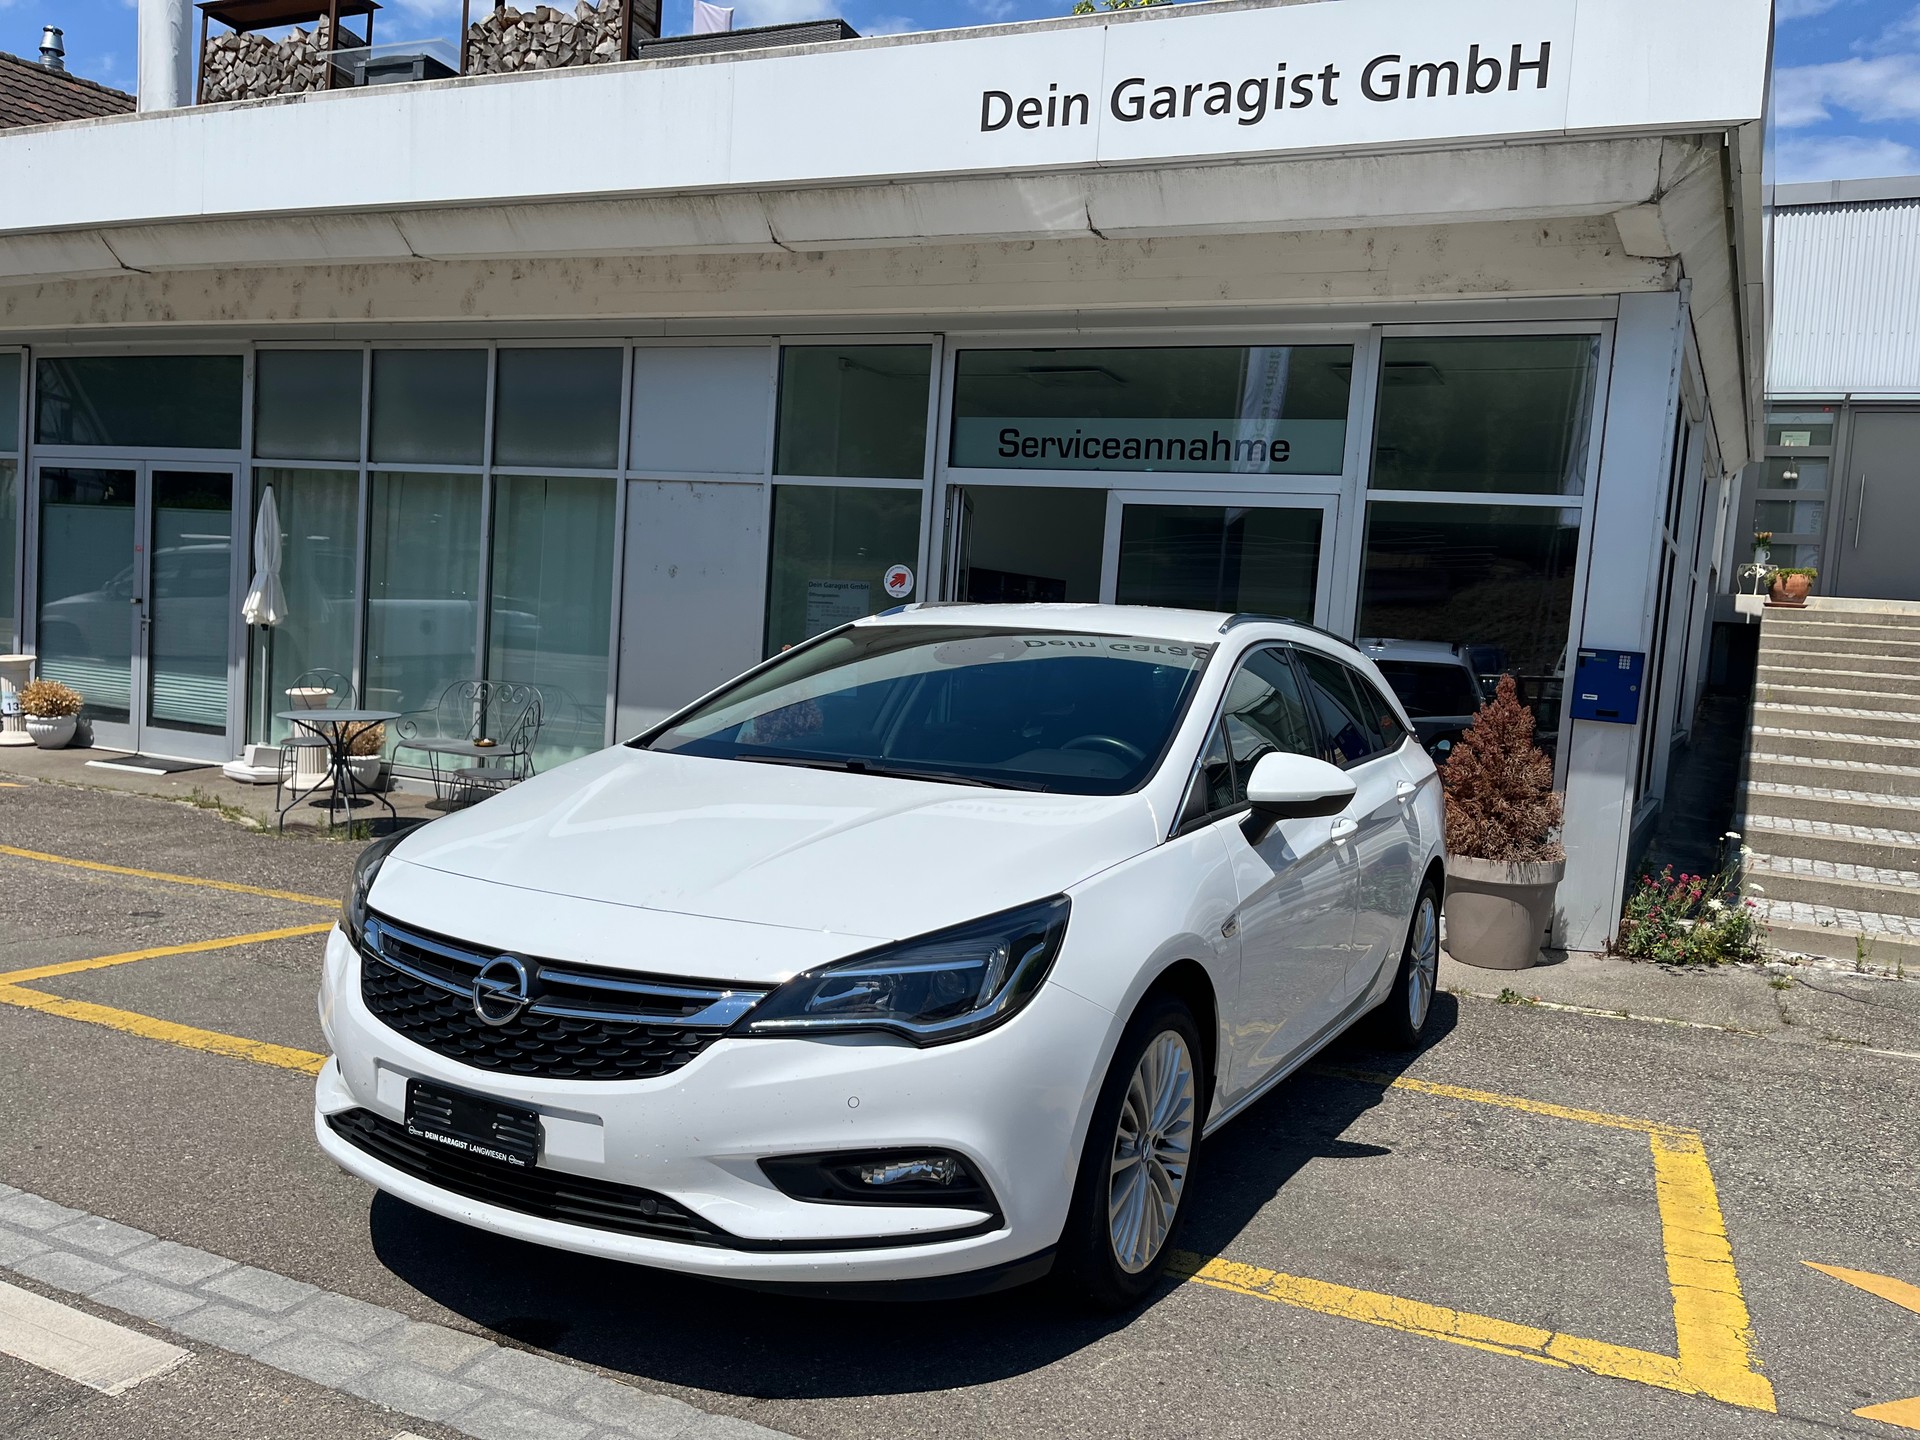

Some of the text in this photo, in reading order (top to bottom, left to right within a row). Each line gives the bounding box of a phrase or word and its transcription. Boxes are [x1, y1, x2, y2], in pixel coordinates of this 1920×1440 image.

[980, 40, 1552, 132] Dein Garagist GmbH
[998, 428, 1291, 463] Serviceannahme
[823, 582, 849, 590] Garagist
[7, 702, 20, 711] 13
[424, 1130, 439, 1141] DEIN
[439, 1135, 468, 1150] GARAGIST
[469, 1144, 508, 1162] LANGWIESEN
